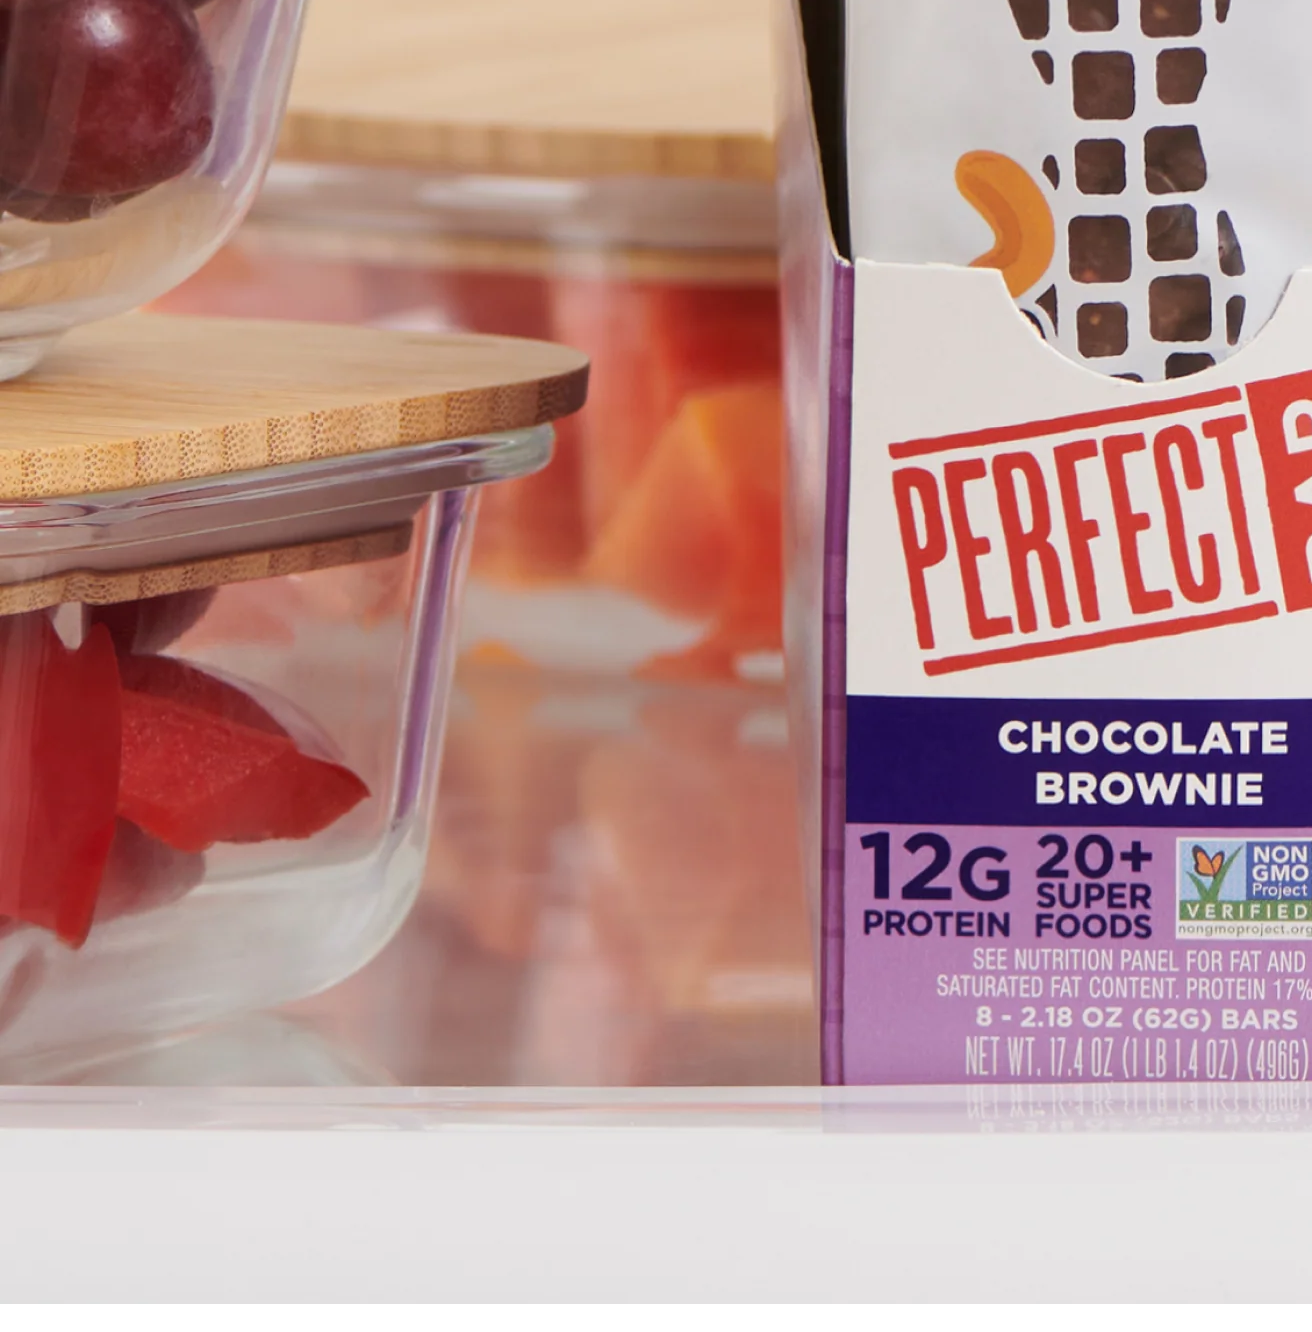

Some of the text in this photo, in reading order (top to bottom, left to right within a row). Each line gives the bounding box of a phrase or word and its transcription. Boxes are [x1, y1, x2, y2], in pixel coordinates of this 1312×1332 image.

[892, 413, 1262, 650] PERFECT
[997, 720, 1290, 755] CHOCOLATE
[1036, 772, 1264, 805] BROWNIE
[860, 831, 1011, 901] 12G
[1036, 833, 1153, 879] 20+
[1253, 845, 1307, 863] NON
[1252, 864, 1309, 882] GMO
[1036, 882, 1153, 910] SUPER
[1253, 882, 1308, 900] Project
[864, 909, 1011, 938] PROTEIN
[1186, 903, 1308, 920] VERIFIED
[1035, 913, 1153, 940] FOODS
[972, 947, 1307, 973] SEE NUTRITION PANEL FOR FAT AND
[936, 974, 1044, 998] SATURATED
[1050, 975, 1083, 998] FAT
[1089, 976, 1180, 999] CONTENT.
[1186, 976, 1266, 1000] PROTEIN
[975, 1006, 993, 1027] 8
[1020, 1006, 1073, 1028] 2.18
[1082, 1007, 1124, 1028] OZ
[1131, 1006, 1213, 1032] (62G)
[1221, 1008, 1299, 1030] BARS
[965, 1036, 999, 1076] NET
[1007, 1036, 1041, 1077] WT.
[1049, 1036, 1083, 1077] 17.4
[1091, 1037, 1113, 1077] OZ
[1145, 1038, 1167, 1078] LB
[1175, 1038, 1199, 1078] 1.4
[1207, 1038, 1238, 1080] OZ)
[1246, 1038, 1310, 1081] (496G)
